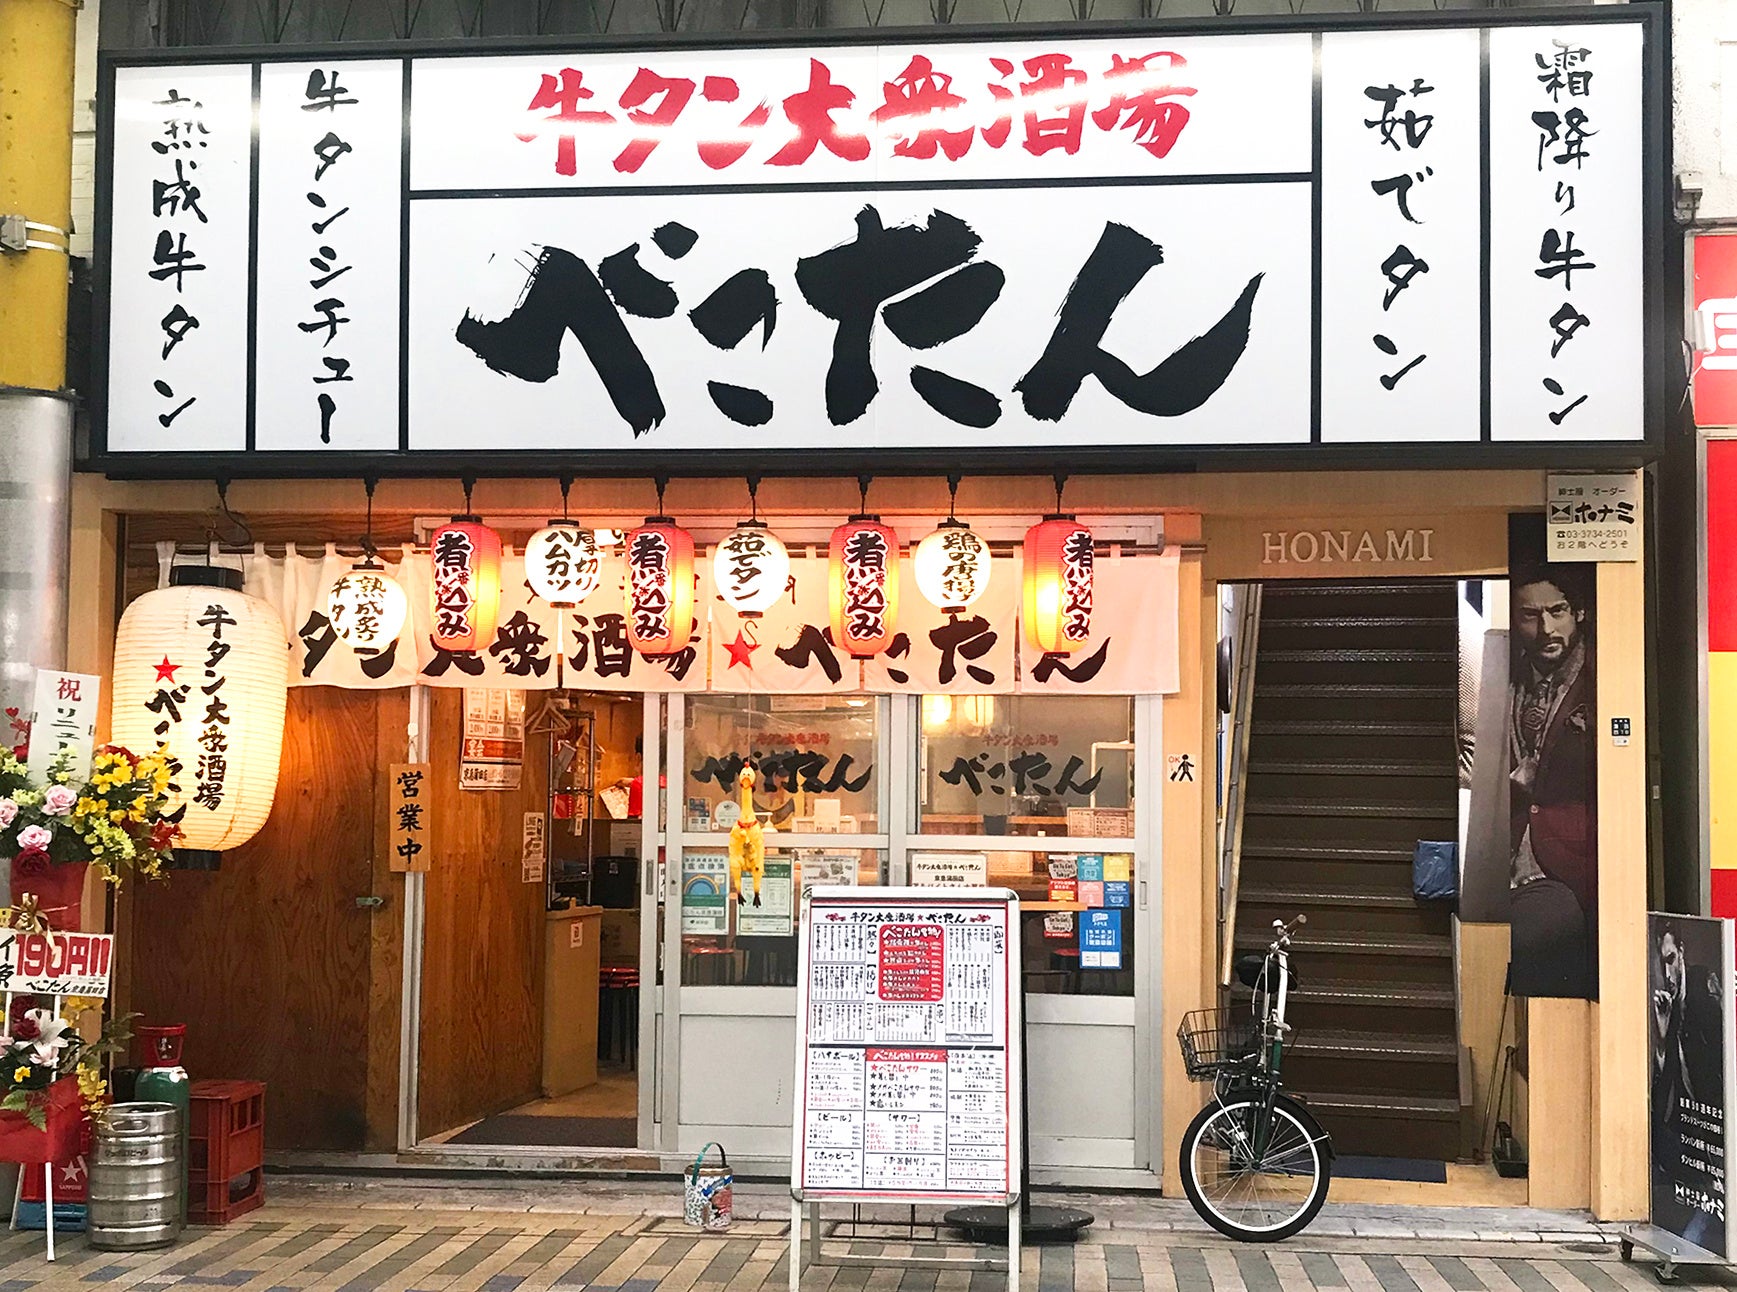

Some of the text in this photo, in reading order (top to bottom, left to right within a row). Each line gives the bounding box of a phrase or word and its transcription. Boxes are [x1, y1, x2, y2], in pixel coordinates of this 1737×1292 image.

[518, 52, 1199, 176] 牛タン大衆酒場
[148, 88, 212, 428] 熟成牛タン
[298, 68, 359, 443] 牛タンシチュー
[1362, 77, 1436, 391] 茹でタン
[1533, 40, 1600, 426] 霜降り牛タン
[455, 204, 1266, 438] べこたん
[1565, 529, 1628, 539] 03-3734-2501
[1574, 501, 1635, 524] ホナミ
[1592, 486, 1627, 496] オーダー
[436, 532, 474, 638] 煮込み
[545, 530, 574, 592] ハムカツ
[630, 532, 669, 639] 煮込み
[723, 532, 773, 601] 茹でタン
[845, 532, 887, 638] 煮込み
[1262, 529, 1435, 564] HONAMI
[57, 677, 82, 702] 祝
[193, 604, 237, 812] 牛タン大衆酒場
[397, 770, 424, 865] 営業中
[939, 751, 1104, 797] べこたん
[850, 912, 967, 924] 牛タン大衆酒場 べこたん
